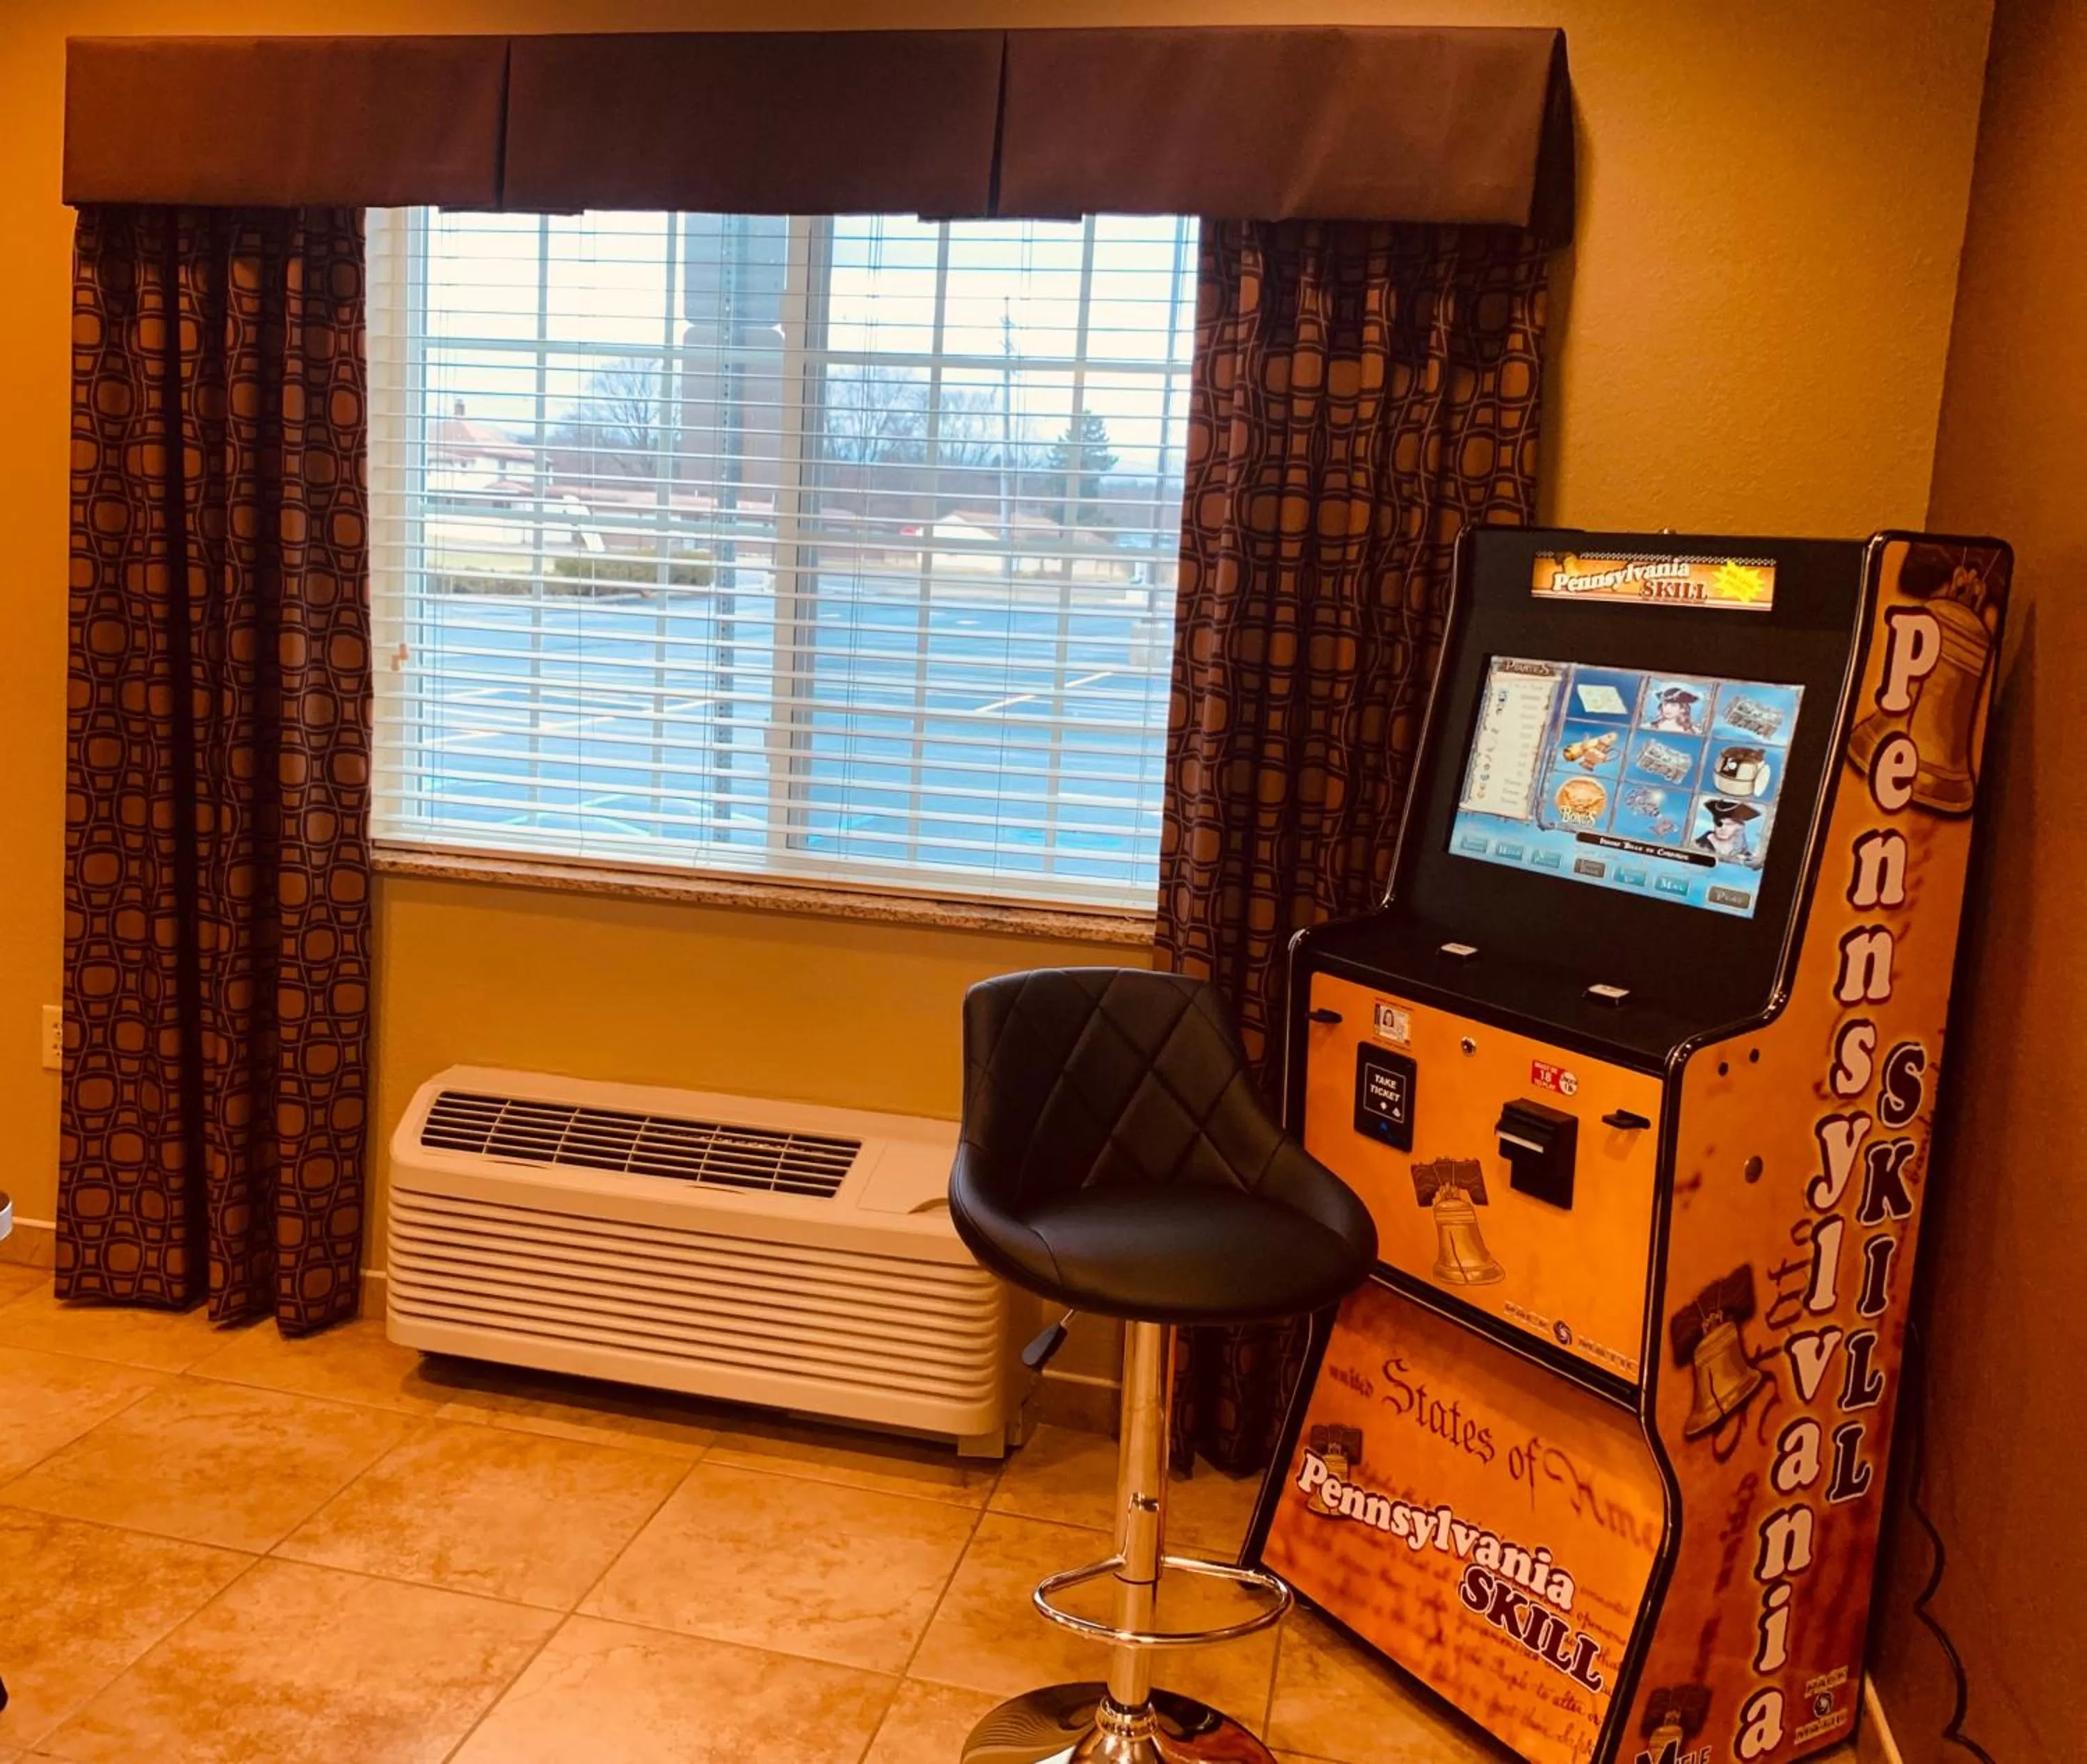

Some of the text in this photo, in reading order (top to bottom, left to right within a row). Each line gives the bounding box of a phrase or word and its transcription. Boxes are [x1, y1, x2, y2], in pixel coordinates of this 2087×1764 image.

[1552, 558, 1690, 591] Pennsylvania
[1639, 579, 1708, 600] SKILL
[1370, 1083, 1401, 1102] TICKET
[1375, 1073, 1397, 1090] TAKE
[1540, 1069, 1552, 1083] 18
[1734, 605, 1941, 1761] Pennsylvania
[1825, 1041, 1925, 1505] SKILL
[1380, 1358, 1495, 1464] States
[1508, 1436, 1542, 1512] of
[1297, 1449, 1575, 1612] Pennsylvania
[1460, 1565, 1604, 1694] SKILL
